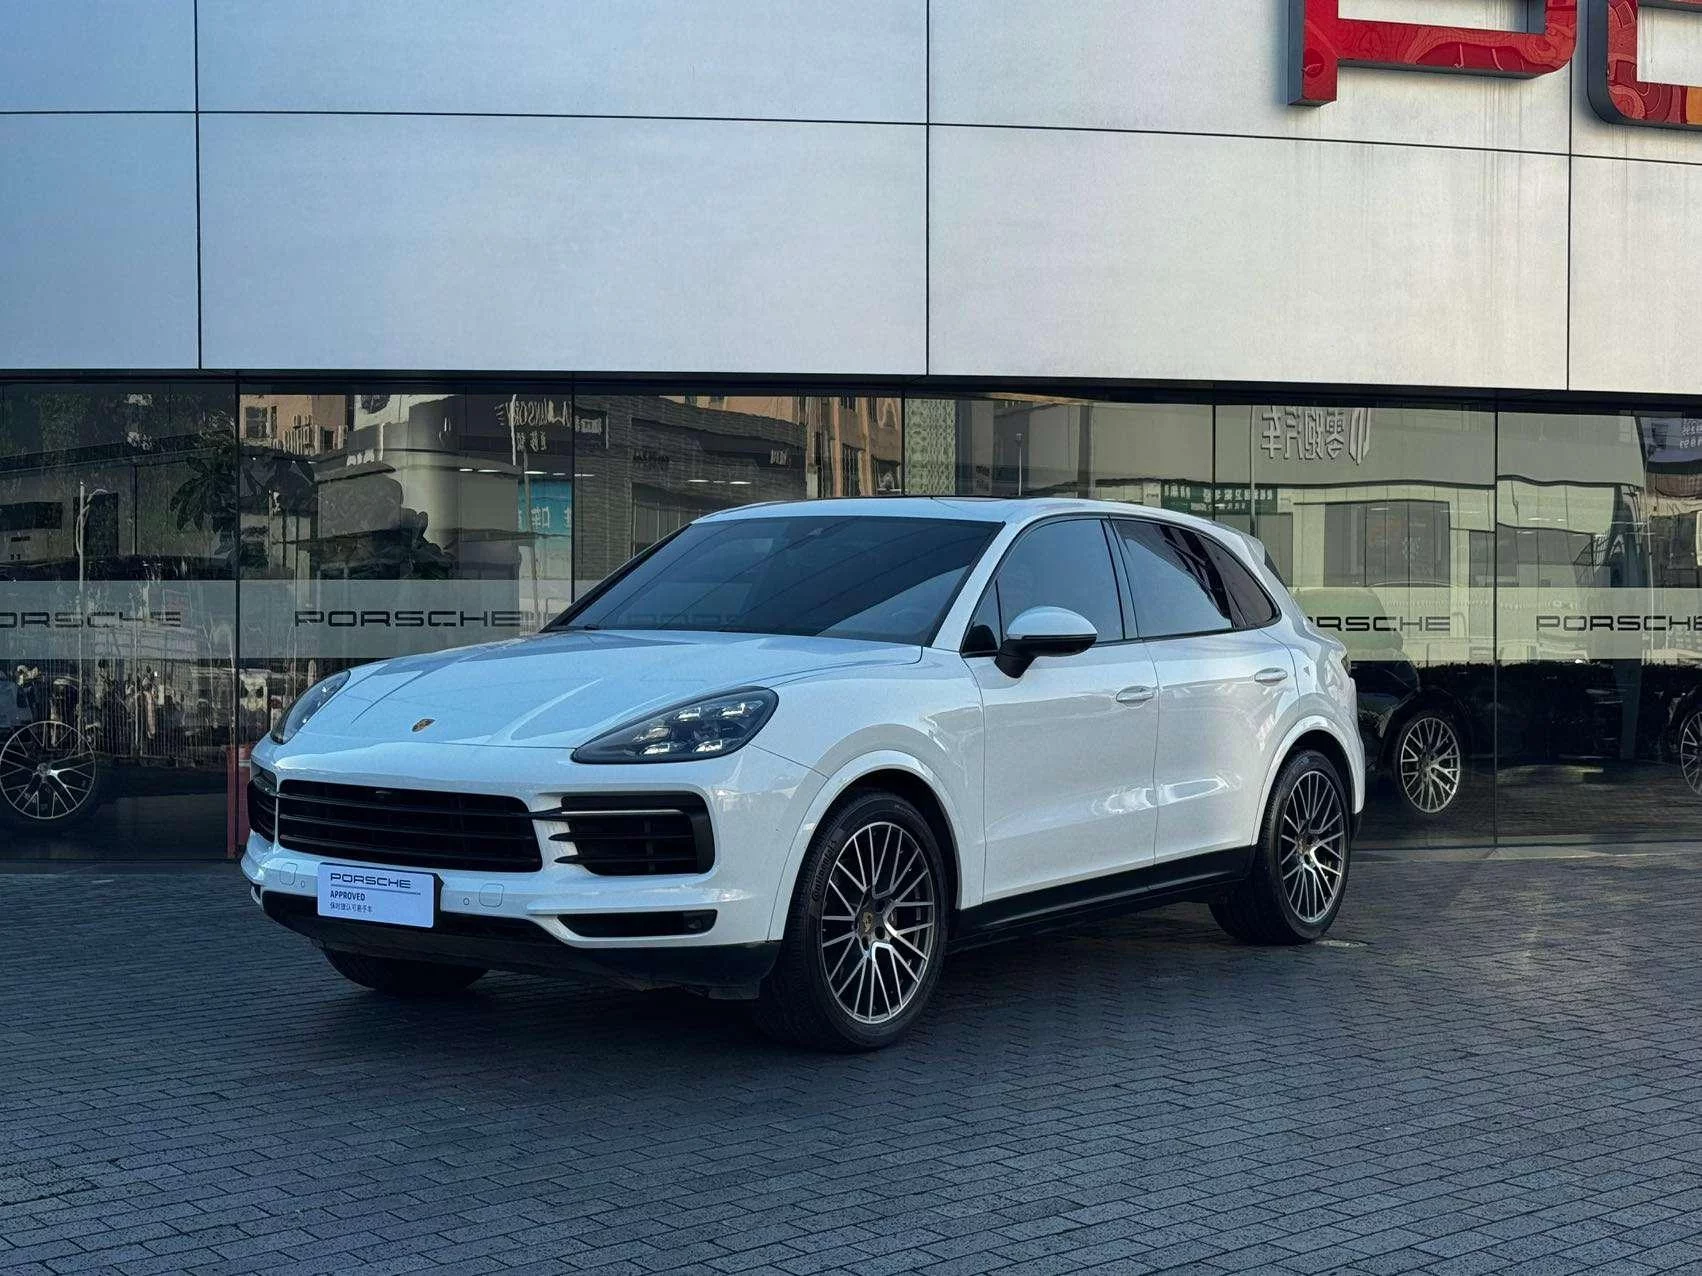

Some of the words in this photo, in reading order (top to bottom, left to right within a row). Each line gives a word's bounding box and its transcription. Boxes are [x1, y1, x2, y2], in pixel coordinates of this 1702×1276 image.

[294, 610, 521, 628] PORSCHE
[1307, 616, 1450, 631] RSCHE
[330, 872, 412, 889] PORSCHE
[330, 890, 366, 901] APPROVED
